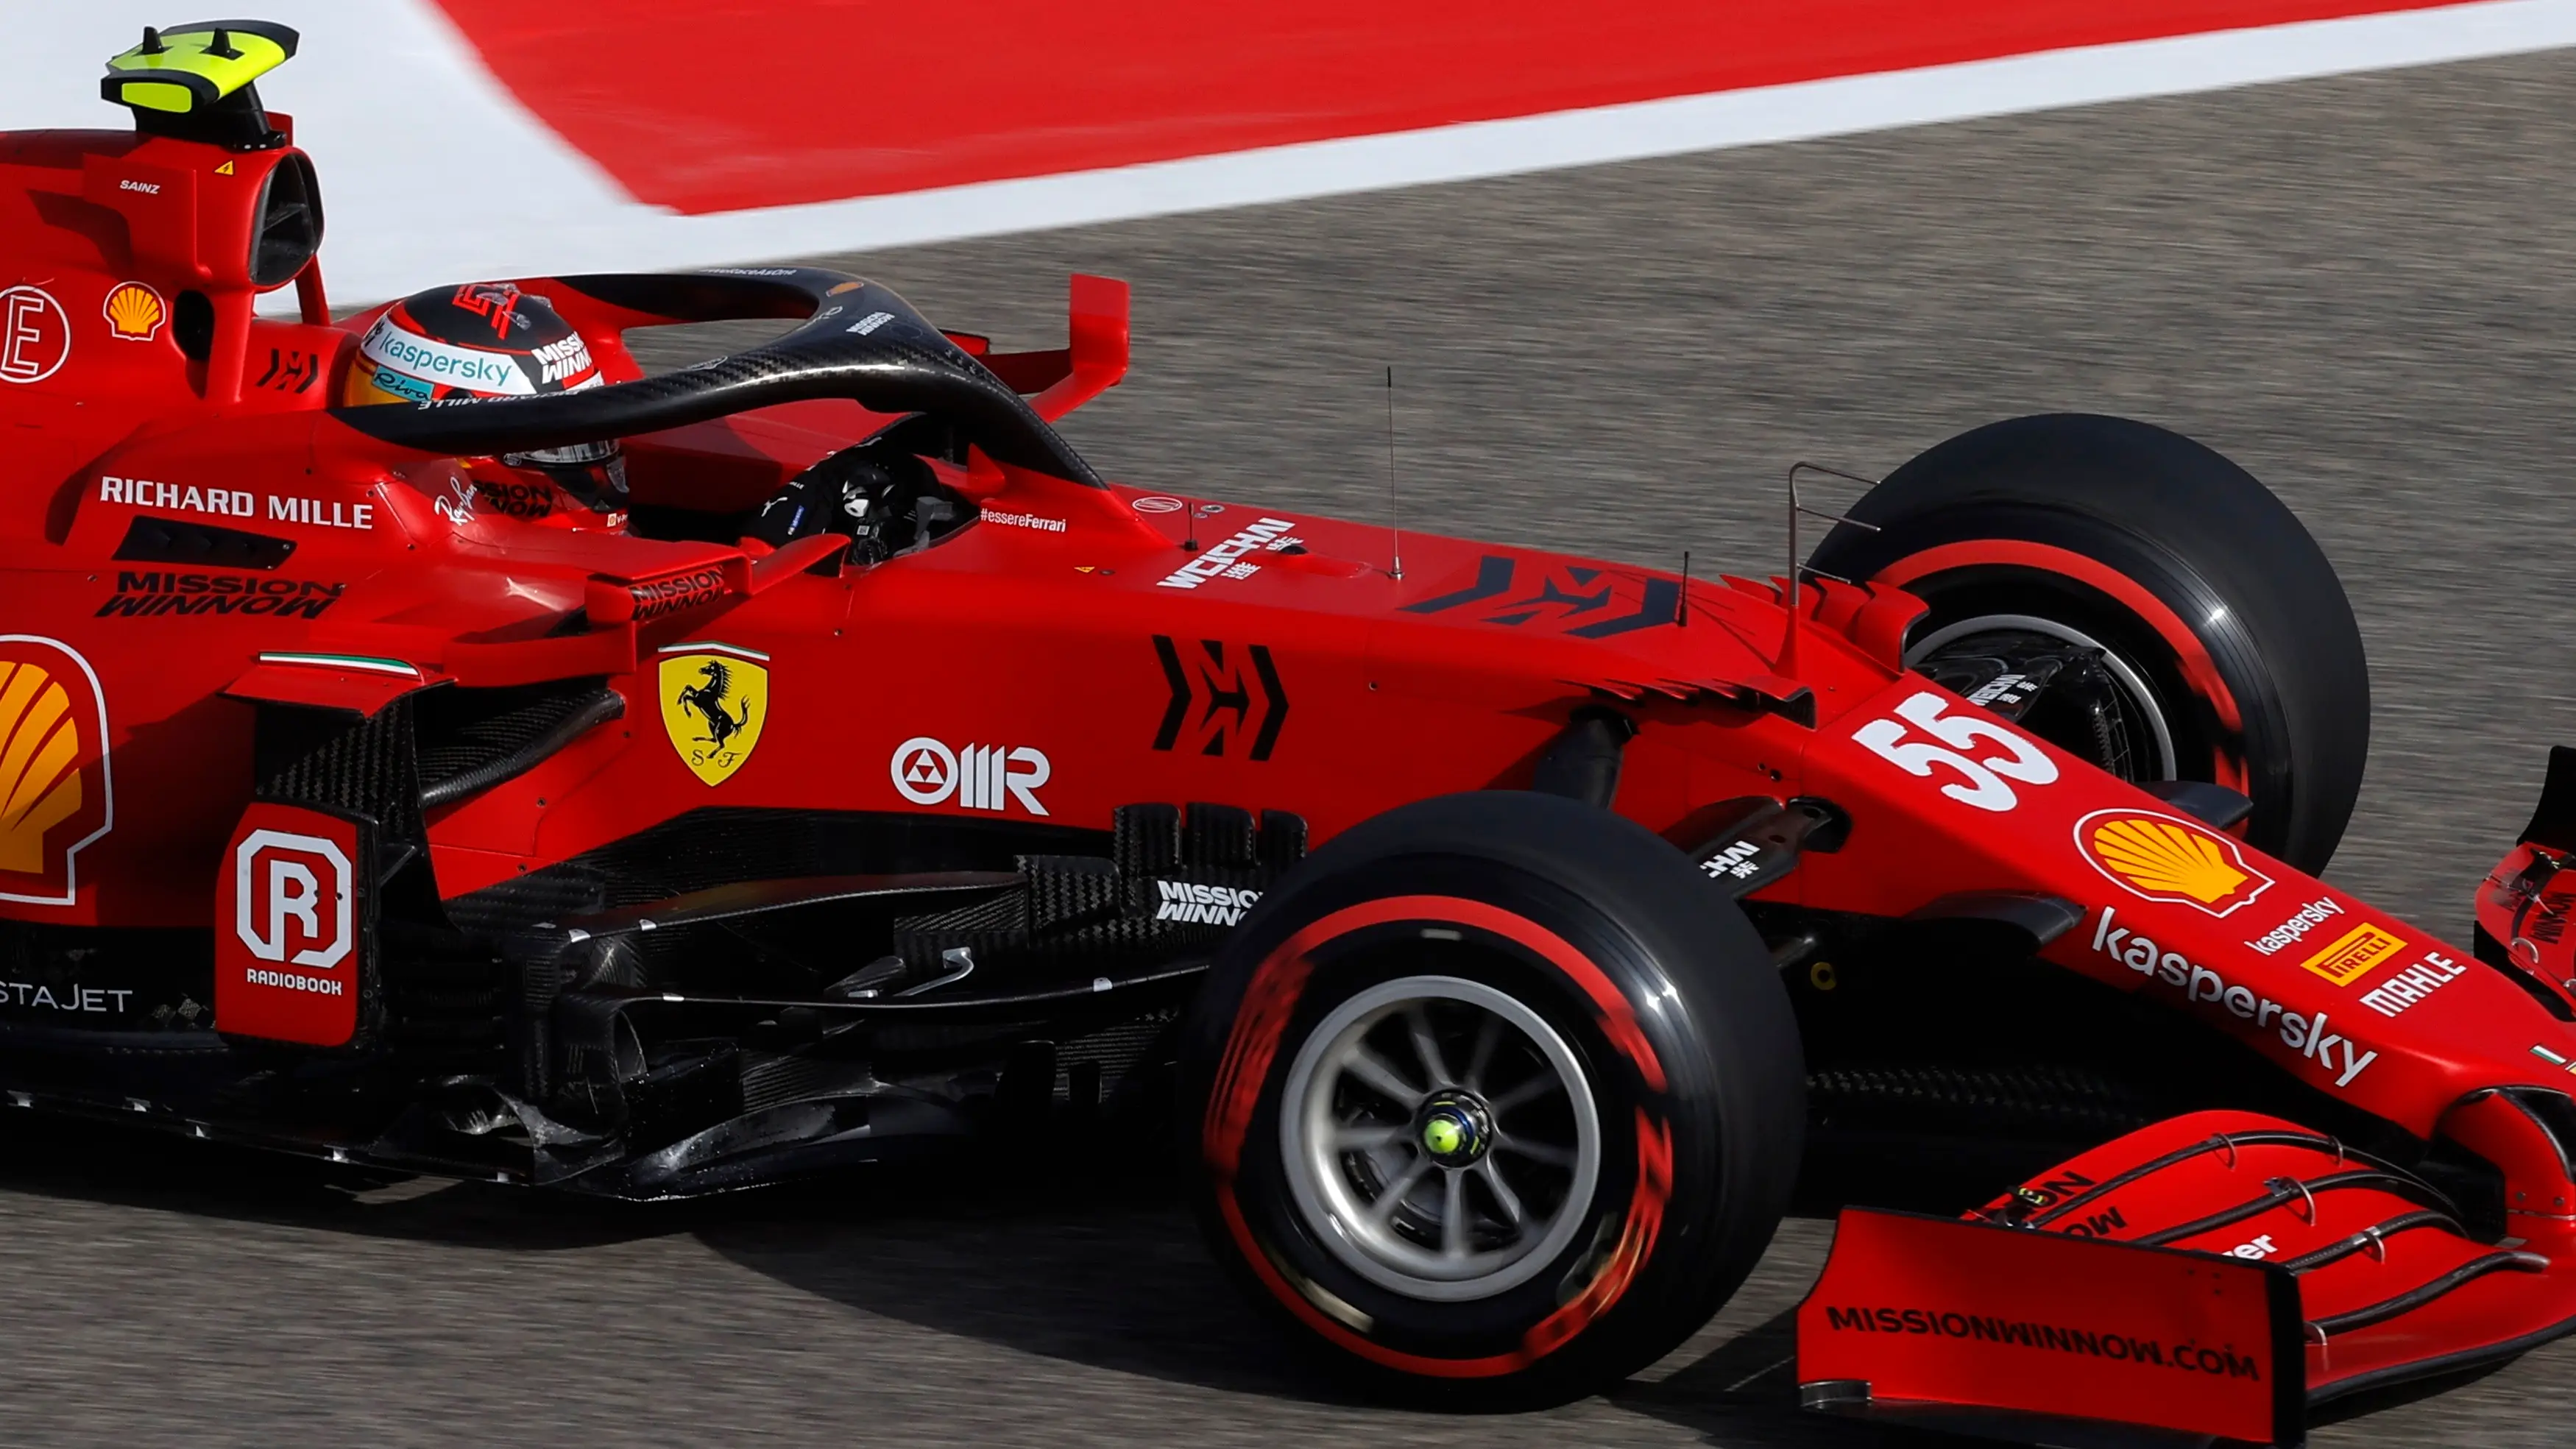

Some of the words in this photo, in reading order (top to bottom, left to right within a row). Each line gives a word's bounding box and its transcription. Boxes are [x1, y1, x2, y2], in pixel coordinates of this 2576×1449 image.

[119, 179, 160, 195] SAINZ
[379, 330, 513, 386] kaspersky
[101, 475, 254, 517] RICHARD
[268, 495, 374, 530] MILLE
[980, 506, 1066, 533] #essereFerrari
[93, 593, 336, 620] WINNOW
[117, 571, 347, 598] MISSION
[691, 748, 705, 767] S
[1851, 691, 2059, 812] 55
[891, 737, 1050, 816] OMR
[1156, 901, 1248, 927] WINN
[1157, 880, 1264, 909] MISSIO
[2243, 896, 2346, 956] kaspersky
[2315, 931, 2392, 979] PIRELLI
[246, 968, 343, 996] RADIOBOOK
[2092, 905, 2378, 1087] kaspersky
[2359, 952, 2468, 1017] MAHLE
[1825, 1305, 2261, 1382] MISSIONWINNOW.COM
